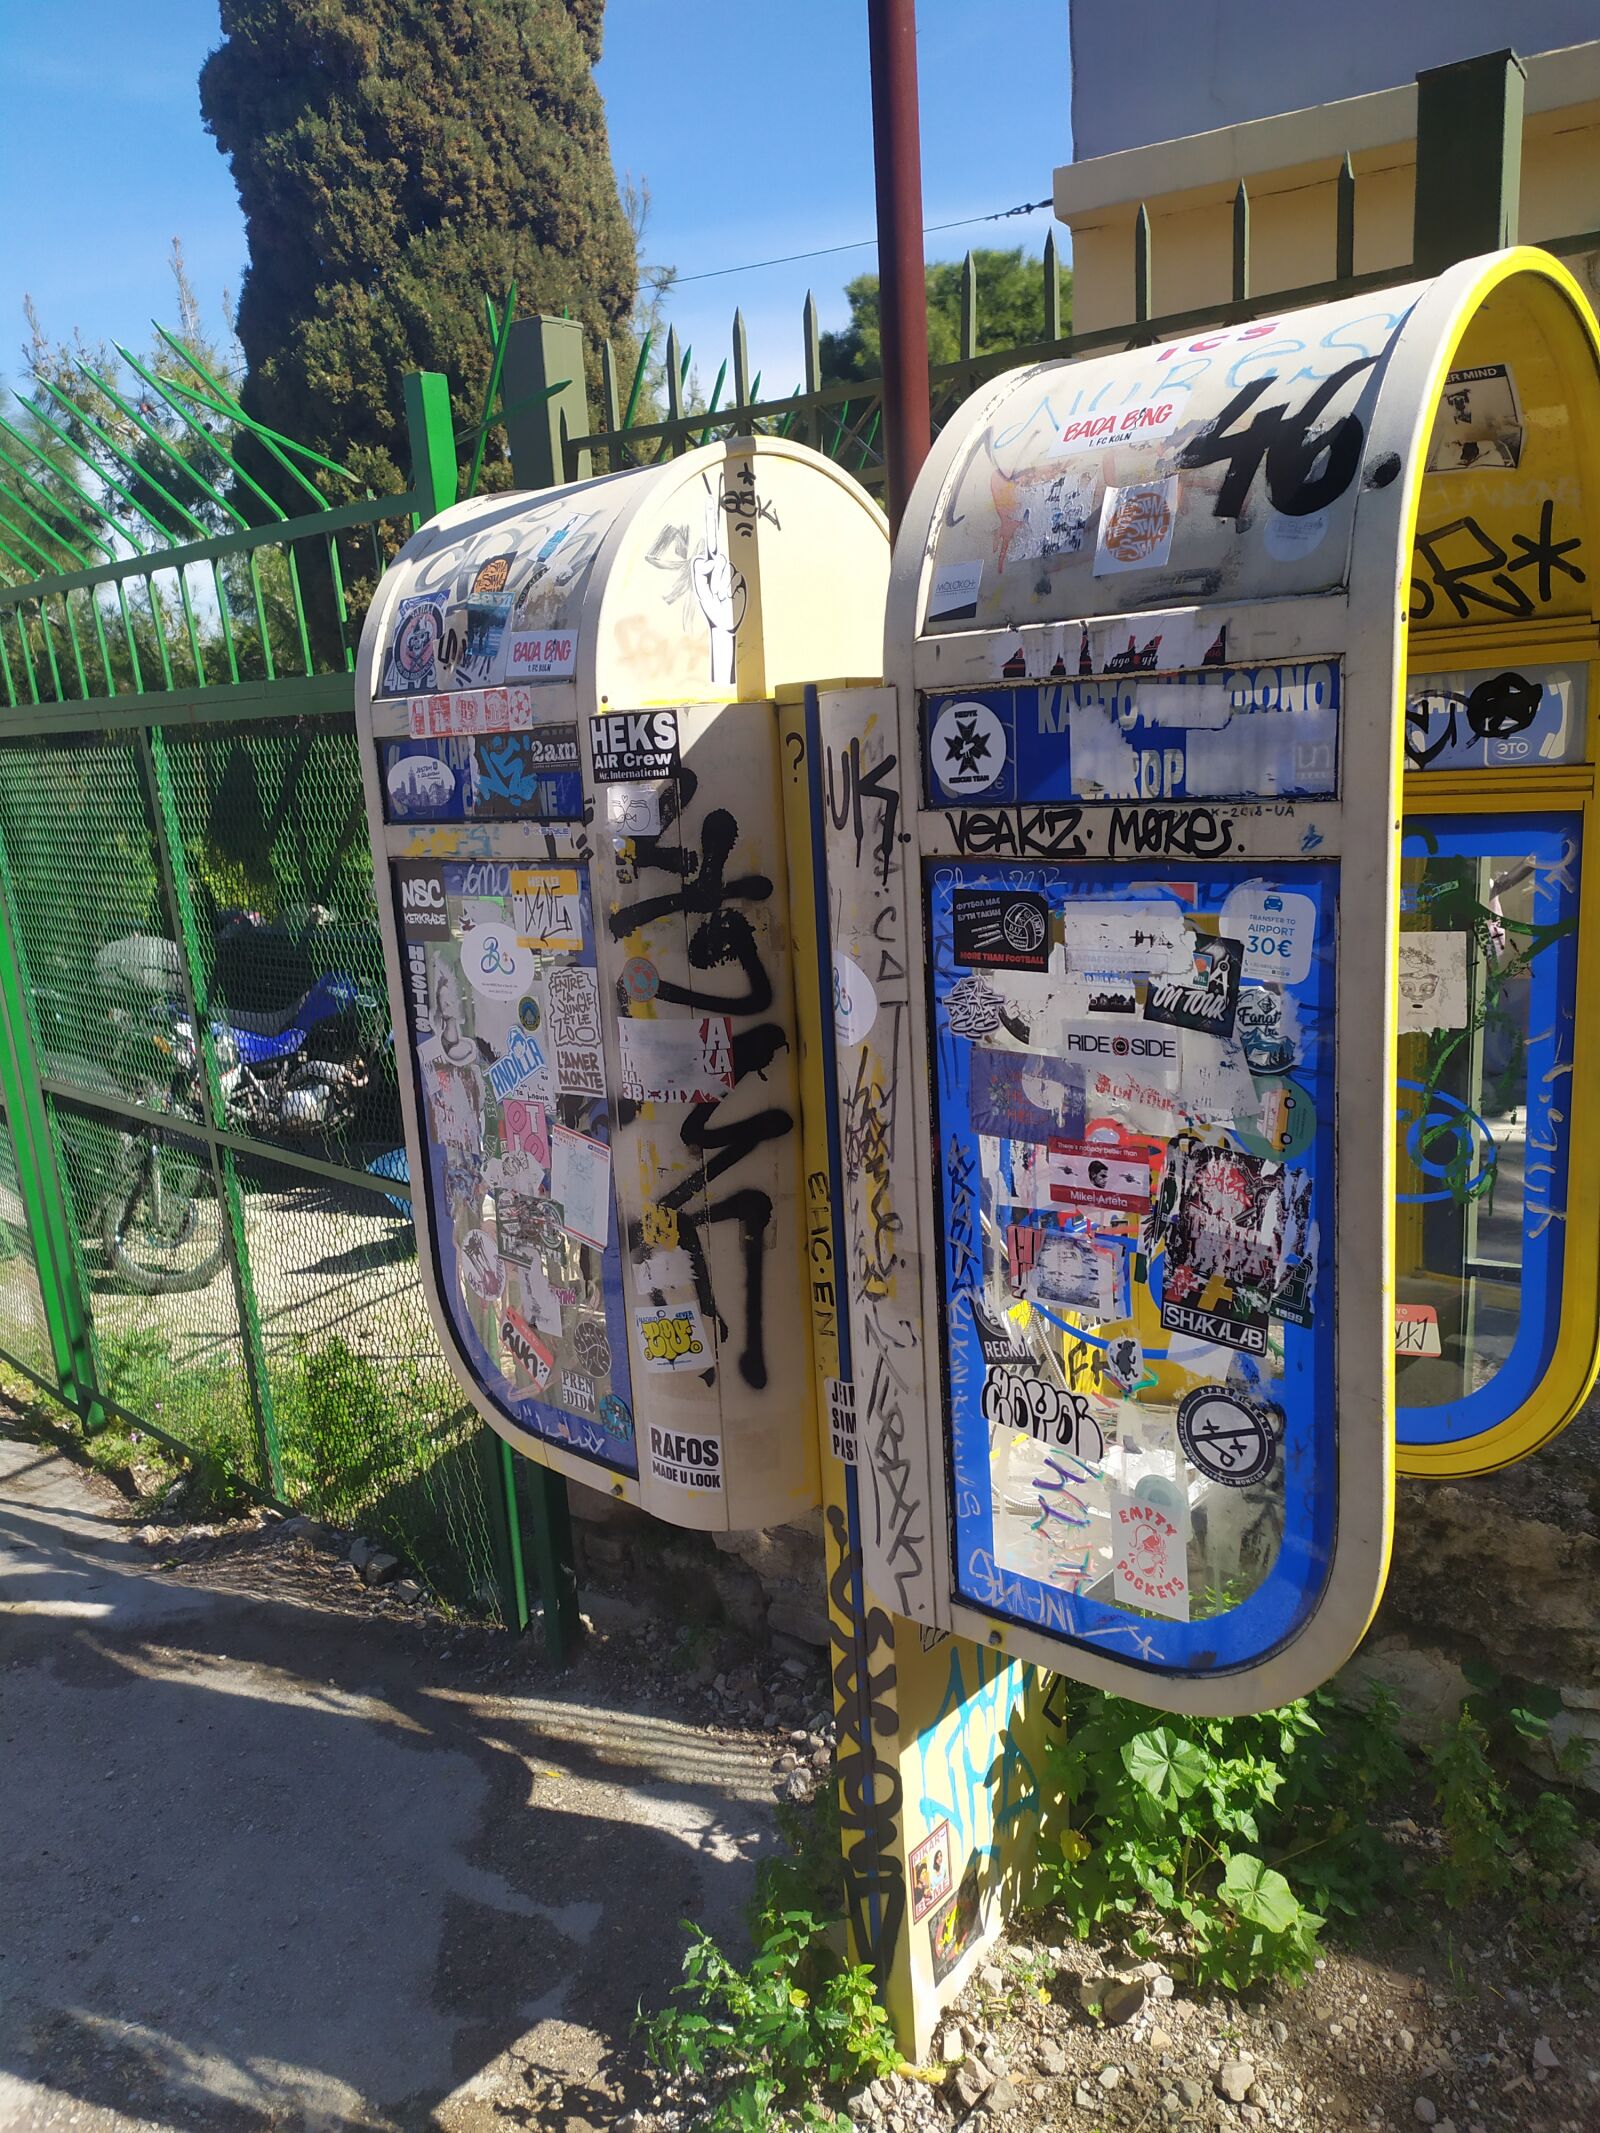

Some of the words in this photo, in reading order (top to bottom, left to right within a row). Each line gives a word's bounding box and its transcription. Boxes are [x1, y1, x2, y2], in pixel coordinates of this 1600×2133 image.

[1463, 367, 1497, 381] MIND
[1062, 415, 1117, 442] BADA
[1096, 437, 1108, 447] FC
[512, 641, 541, 663] BADA
[591, 711, 677, 756] HEKS
[531, 740, 579, 763] 2am
[594, 755, 618, 770] AIR
[623, 753, 673, 767] Crew
[610, 766, 670, 780] International
[402, 879, 446, 908] NSC
[956, 899, 985, 911] ФУТБОЛ
[404, 912, 447, 926] KERKRADE
[957, 912, 976, 922] БУТИ
[1249, 914, 1285, 924] TRANSFER
[1287, 918, 1296, 926] TO
[1247, 923, 1296, 937] AIRPORT
[1246, 935, 1294, 958] 30€
[959, 951, 982, 961] MORE
[982, 952, 1005, 962] THAN
[1005, 953, 1045, 965] FOOTBALL
[552, 974, 586, 993] ENTRE
[562, 988, 575, 1003] LA
[1182, 989, 1230, 1022] TOUR
[553, 1017, 596, 1043] ZOO
[564, 1014, 576, 1026] ET
[577, 1014, 592, 1026] LE
[1067, 1034, 1111, 1054] RIDE
[1130, 1037, 1177, 1058] SIDE
[556, 1050, 600, 1072] L'AMER
[558, 1069, 604, 1090] MONTE
[1057, 1141, 1076, 1151] There's
[1080, 1144, 1103, 1155] nobody
[1103, 1146, 1122, 1156] better
[1123, 1149, 1138, 1158] than
[1070, 1190, 1096, 1202] Mikel
[1098, 1193, 1128, 1207] Arteta
[1165, 1305, 1264, 1351] SHAKALAB
[562, 1369, 594, 1394] PREN
[650, 1427, 720, 1468] RAFOS
[652, 1462, 678, 1483] MADE
[679, 1466, 688, 1484] U
[689, 1466, 722, 1489] LOOK
[1118, 1505, 1179, 1538] EMPTY
[1116, 1560, 1186, 1600] POCKETS
